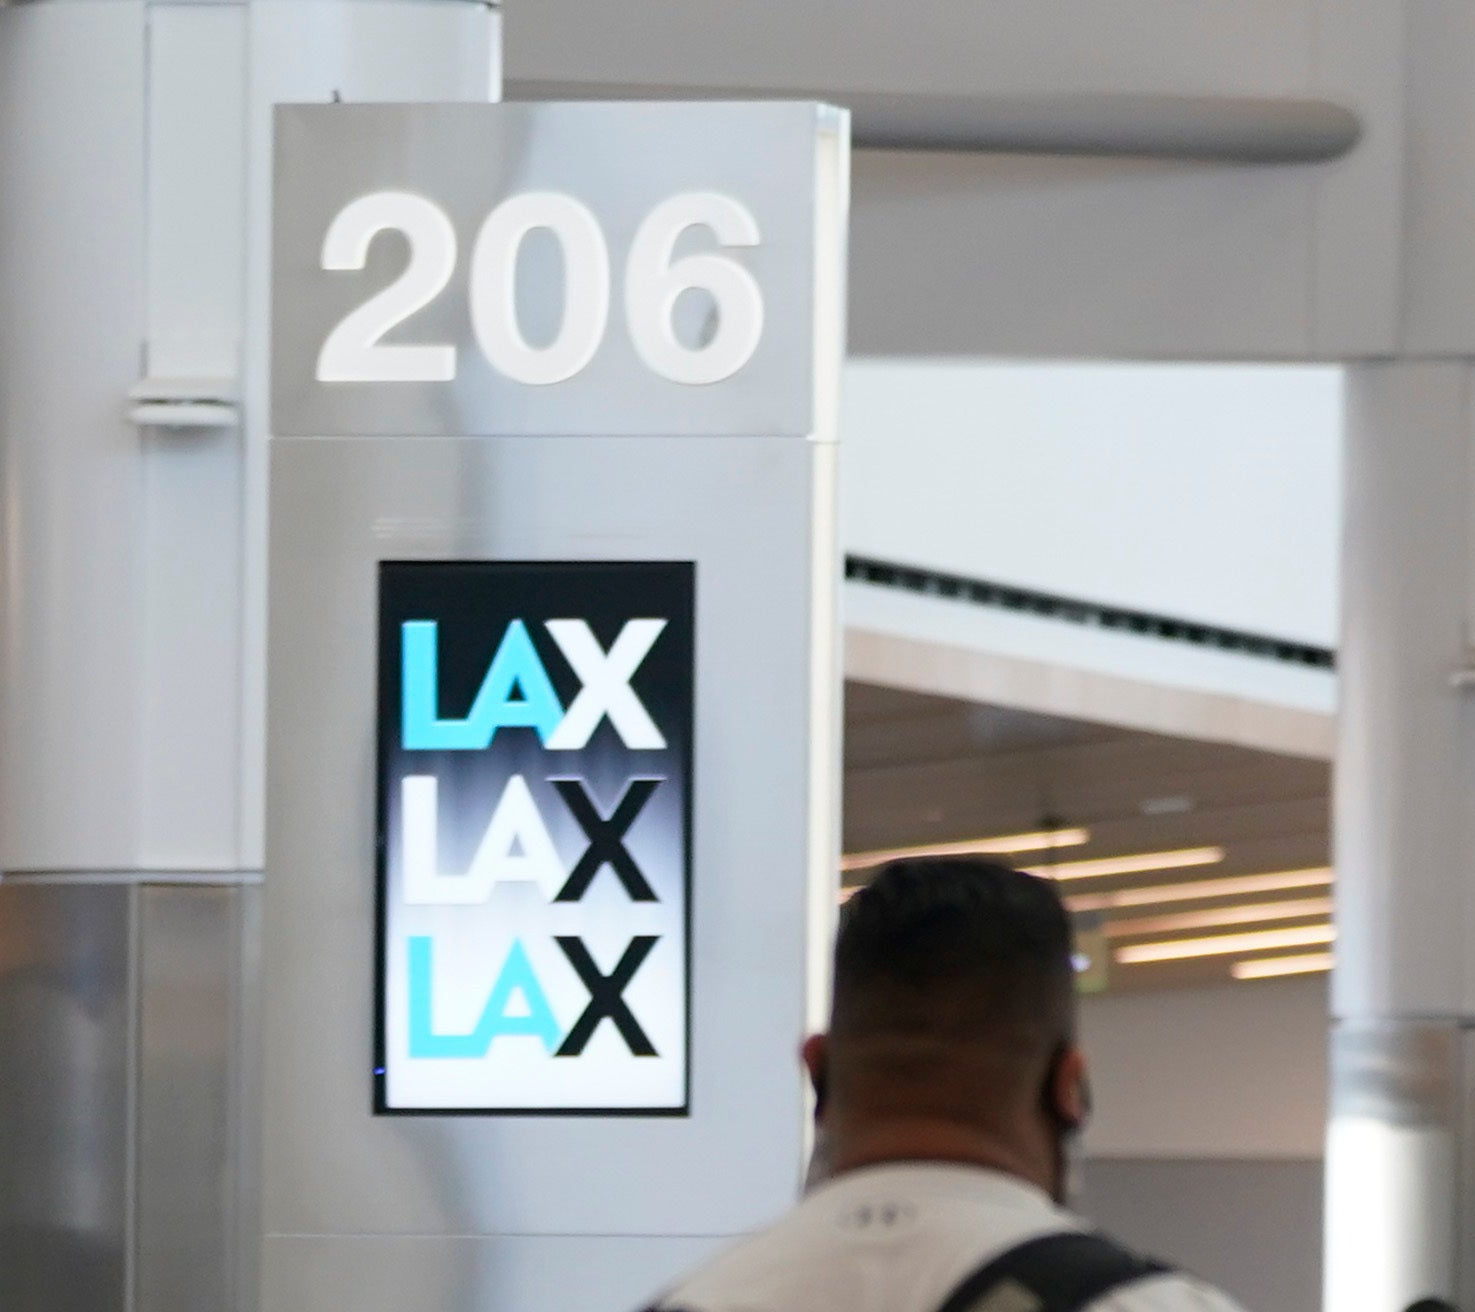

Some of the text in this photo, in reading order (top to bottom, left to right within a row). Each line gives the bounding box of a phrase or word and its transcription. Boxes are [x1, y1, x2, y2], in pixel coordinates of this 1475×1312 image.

[316, 190, 764, 385] 206
[400, 617, 668, 750] LAX
[400, 775, 665, 904] LAX
[405, 934, 662, 1059] LAX
